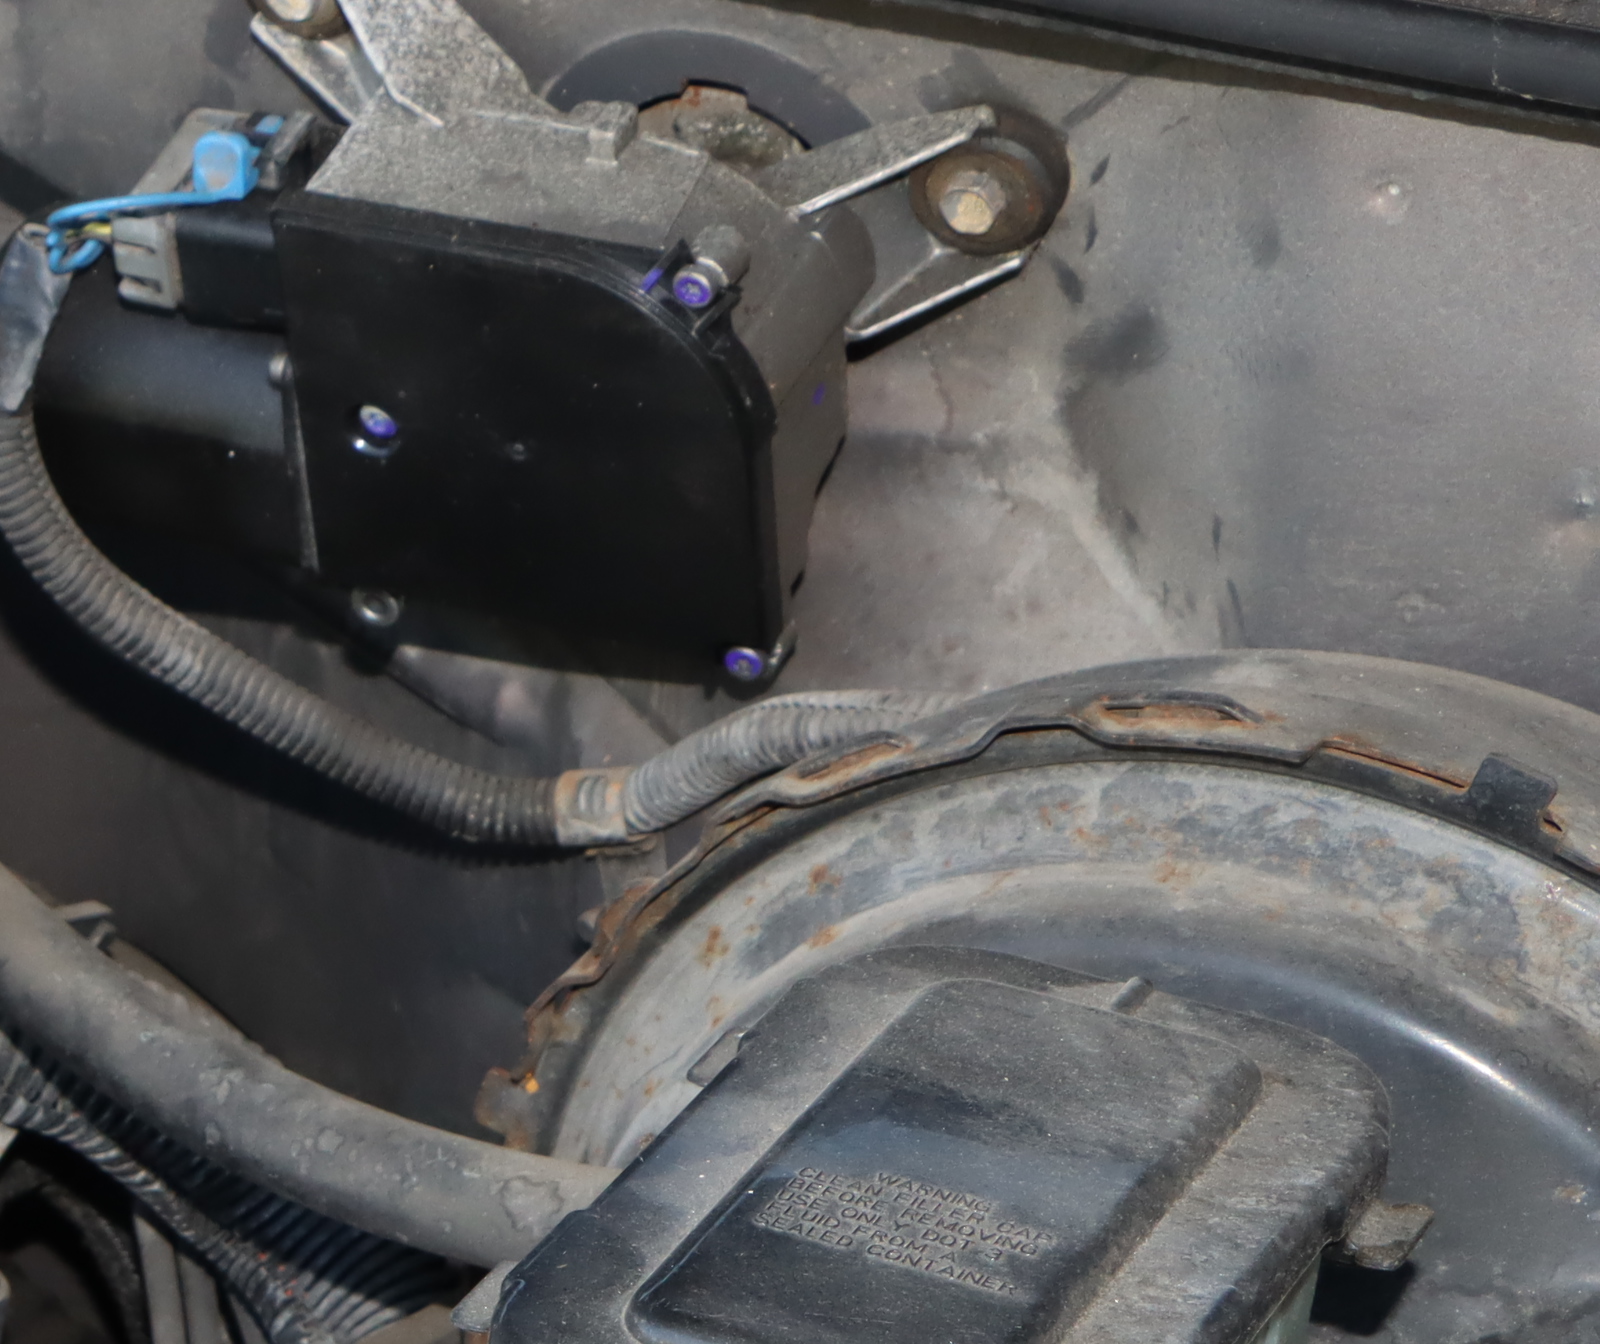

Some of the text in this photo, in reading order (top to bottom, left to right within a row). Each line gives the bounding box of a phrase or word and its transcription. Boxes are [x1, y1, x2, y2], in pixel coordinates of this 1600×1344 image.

[777, 1189, 1003, 1262] USE ONLY DOT 3
[787, 1178, 1039, 1256] BEFORE REMOVING
[798, 1167, 1052, 1241] CLEAN FILLER CAP
[877, 1172, 992, 1213] WARNING
[754, 1212, 1019, 1297] SEALED CONTAINER
[766, 1201, 956, 1264] FLUID FROM A
